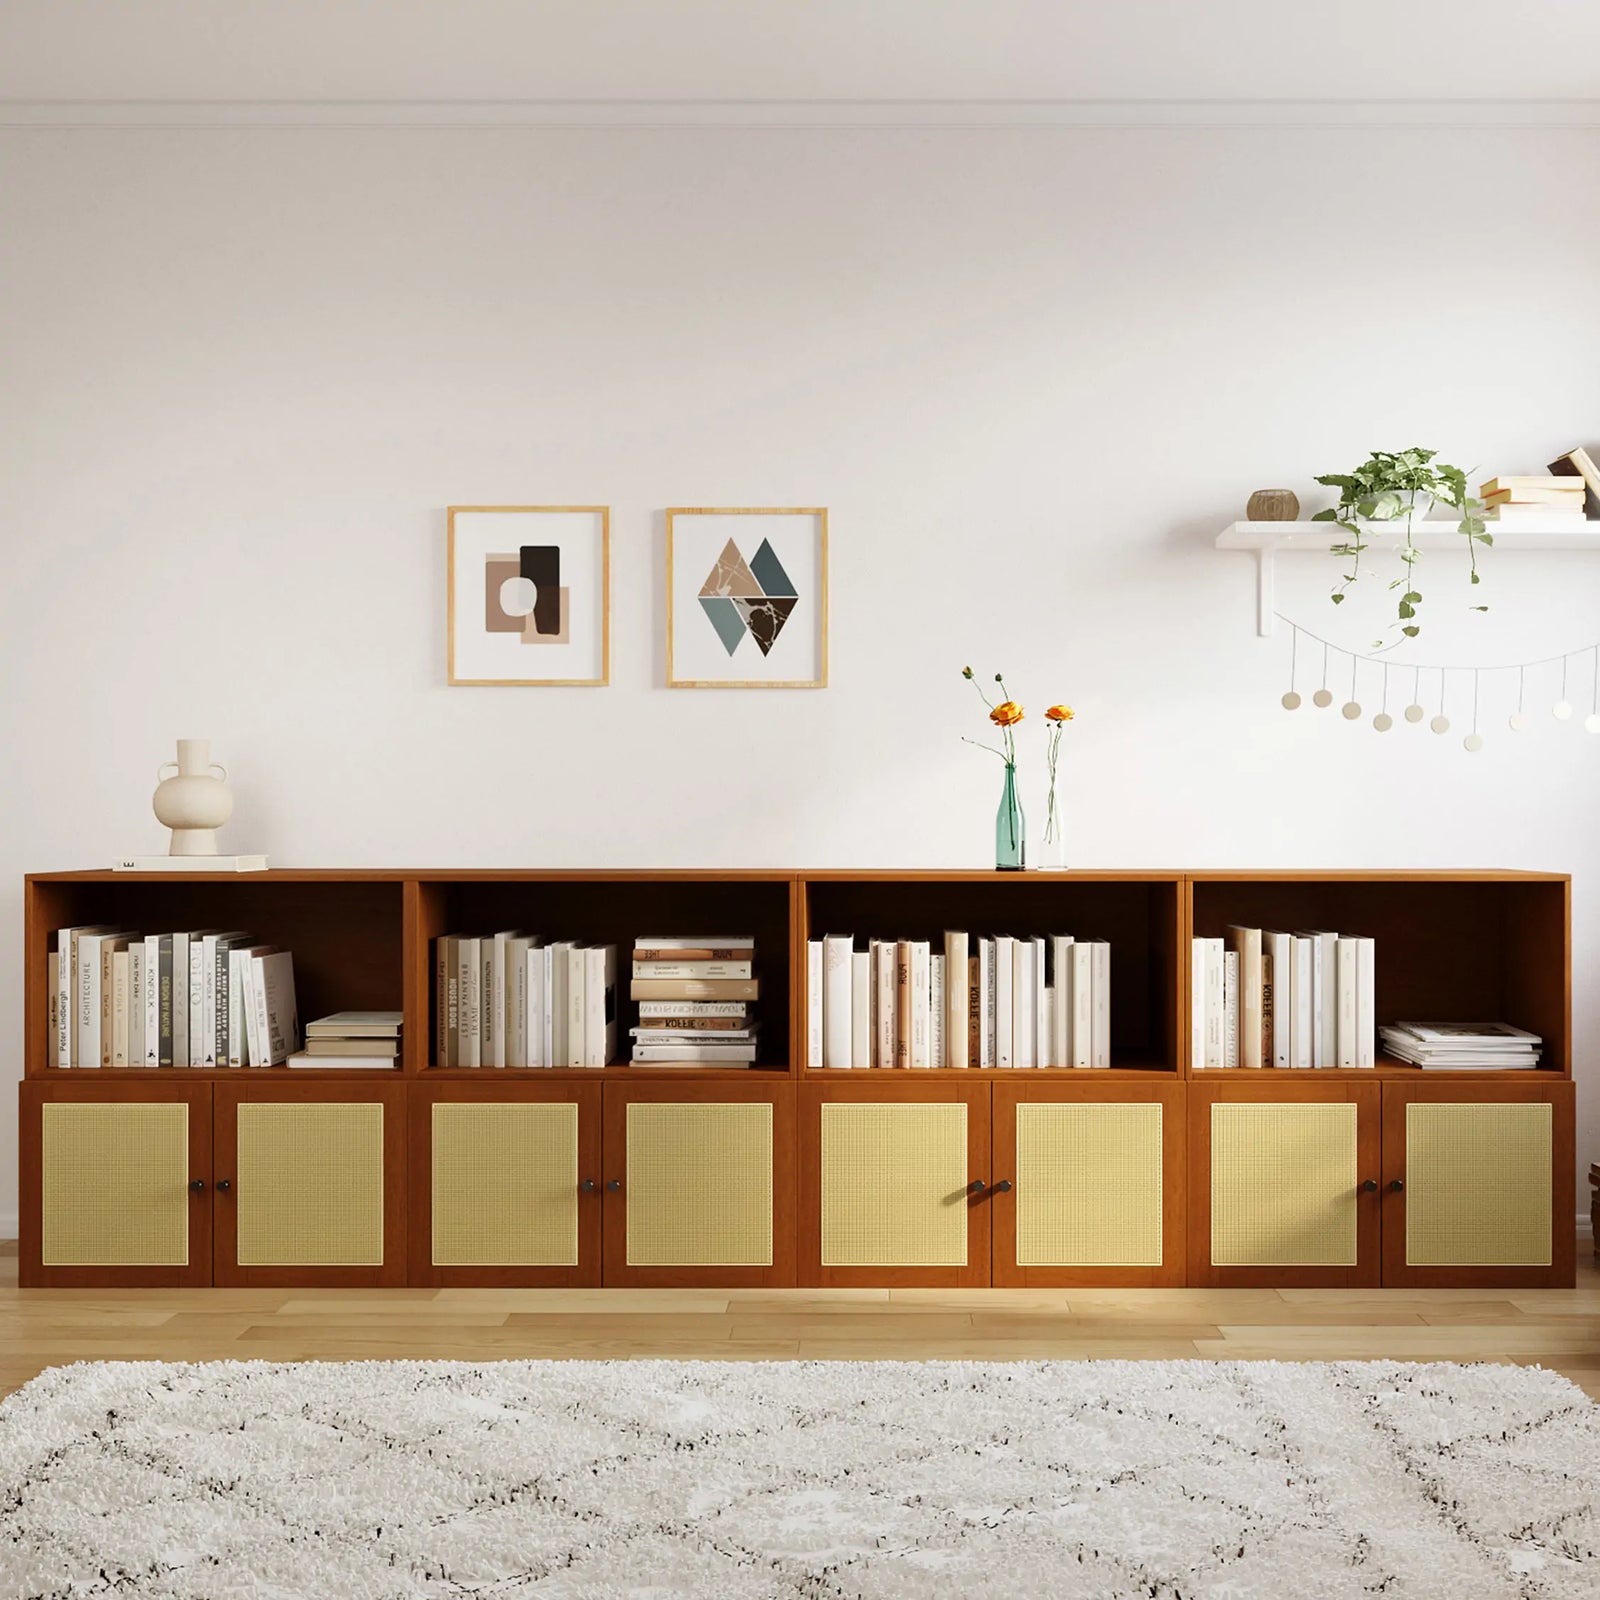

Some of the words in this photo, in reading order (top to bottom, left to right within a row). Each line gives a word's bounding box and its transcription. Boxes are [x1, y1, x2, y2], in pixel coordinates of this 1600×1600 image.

[83, 962, 91, 1027] ARCHITECTURE
[147, 969, 155, 1008] KINFOLK
[161, 976, 170, 1000] DESIGN
[449, 978, 457, 1005] HOUSE
[59, 990, 68, 1031] Lindbergh
[161, 1002, 170, 1011] BY
[449, 1007, 457, 1029] BOOK
[161, 1012, 170, 1038] NATURE
[222, 1030, 227, 1039] OF
